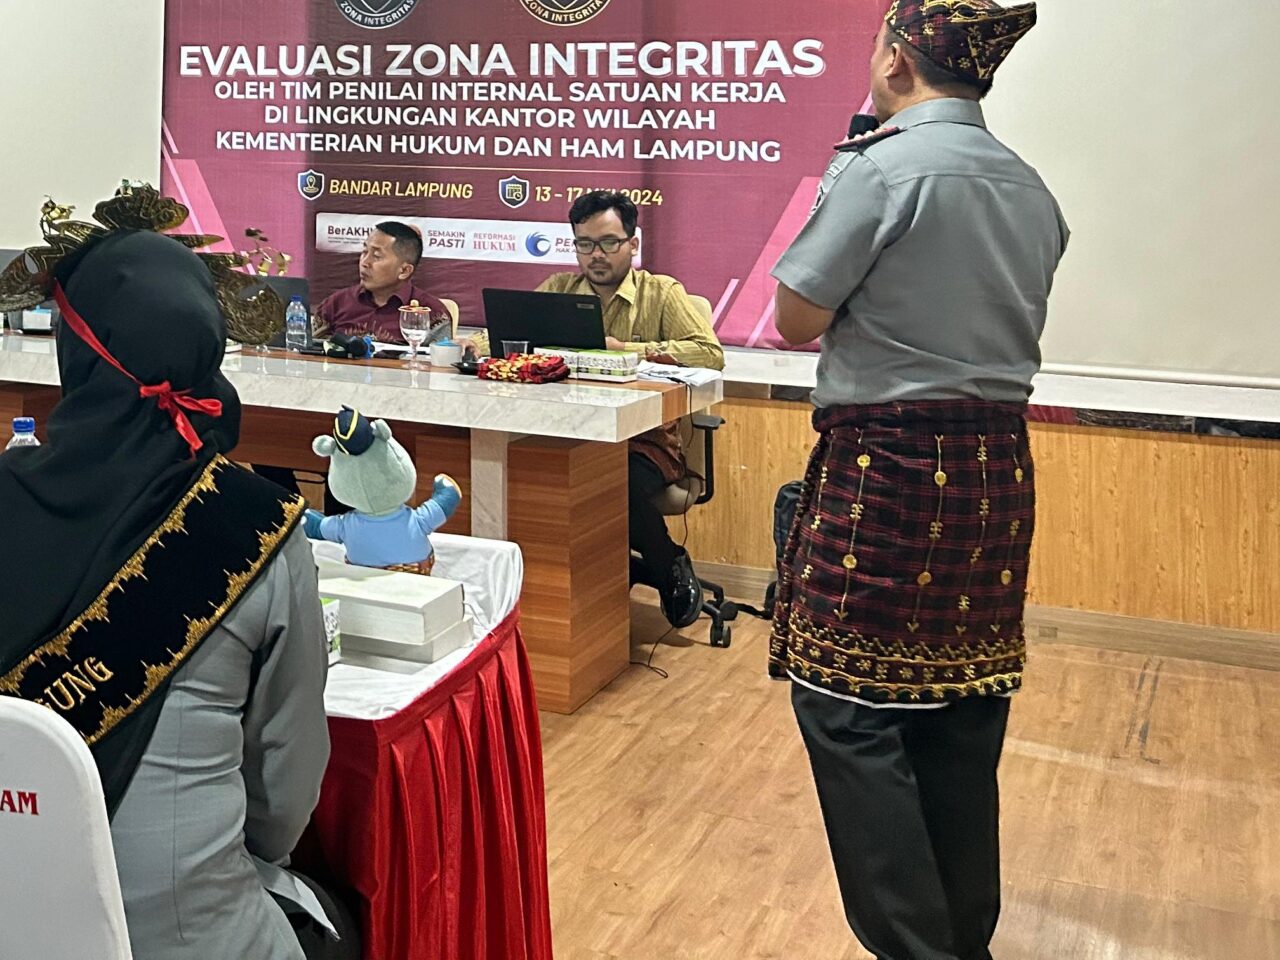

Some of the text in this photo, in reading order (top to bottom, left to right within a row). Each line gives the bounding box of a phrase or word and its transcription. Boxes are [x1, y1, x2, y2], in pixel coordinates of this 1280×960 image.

[340, 0, 414, 25] ZONA INTEGRITAS
[179, 39, 826, 78] EVALUASI ZONA INTEGRITAS
[214, 81, 787, 103] OLEH TIM PENILAI INTERNAL SATUAN KERJA
[264, 105, 716, 130] DI LINGKUNGAN KANTOR WILAYAH
[216, 131, 781, 162] KEMENTERIAN HUKUM DAN HAM LAMPUNG
[329, 179, 473, 199] BANDAR LAMPUNG
[535, 186, 552, 202] 13
[428, 230, 465, 238] SEMAKIN
[428, 238, 465, 249] PASTI
[473, 232, 516, 241] REFORMASI
[473, 241, 516, 252] HUKUM
